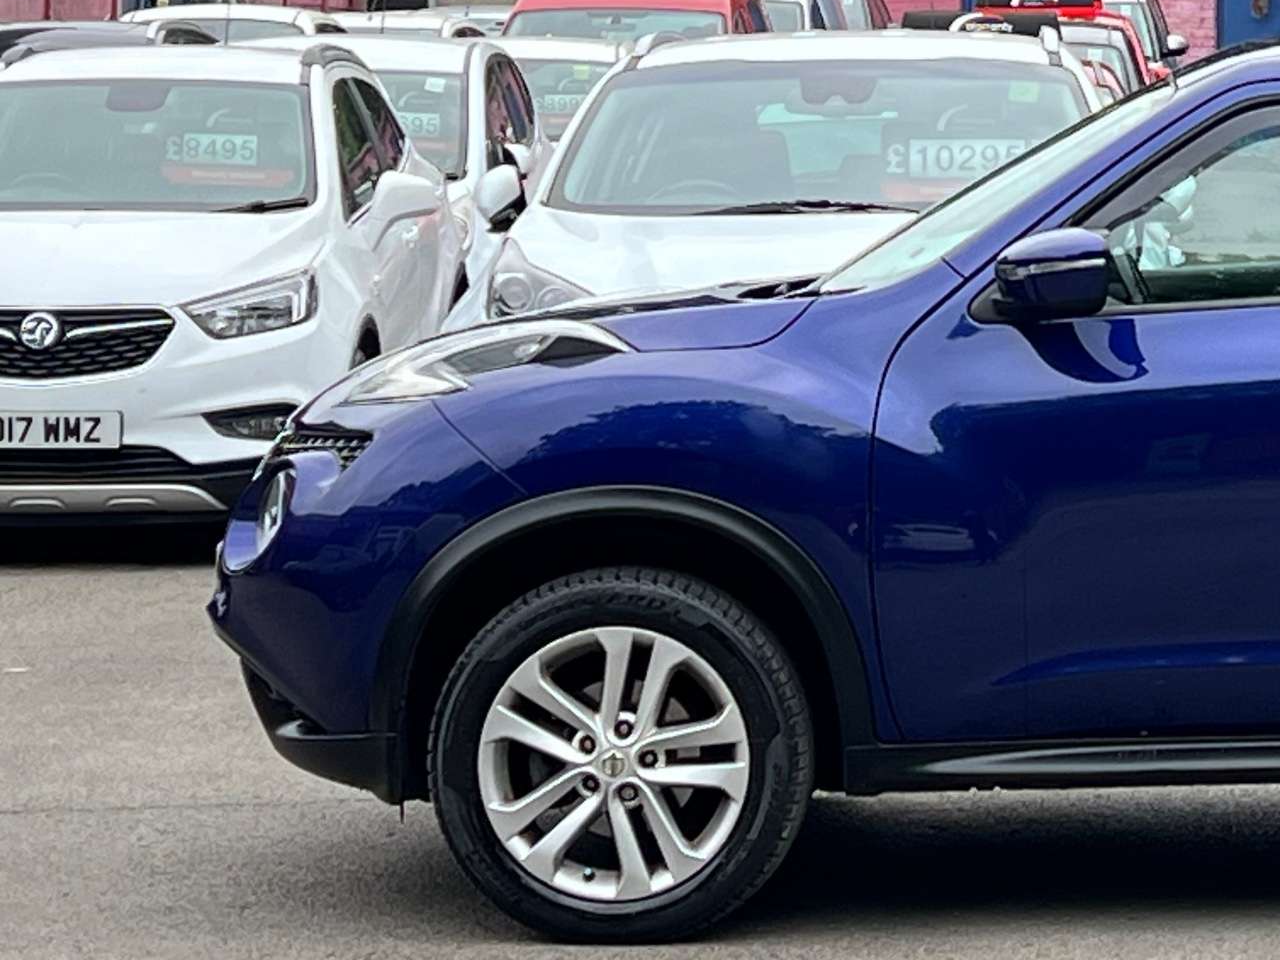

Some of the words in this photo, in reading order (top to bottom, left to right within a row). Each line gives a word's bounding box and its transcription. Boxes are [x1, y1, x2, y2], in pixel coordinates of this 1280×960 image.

[165, 136, 255, 161] £8495
[0, 416, 33, 443] 17
[43, 416, 101, 443] WMZ
